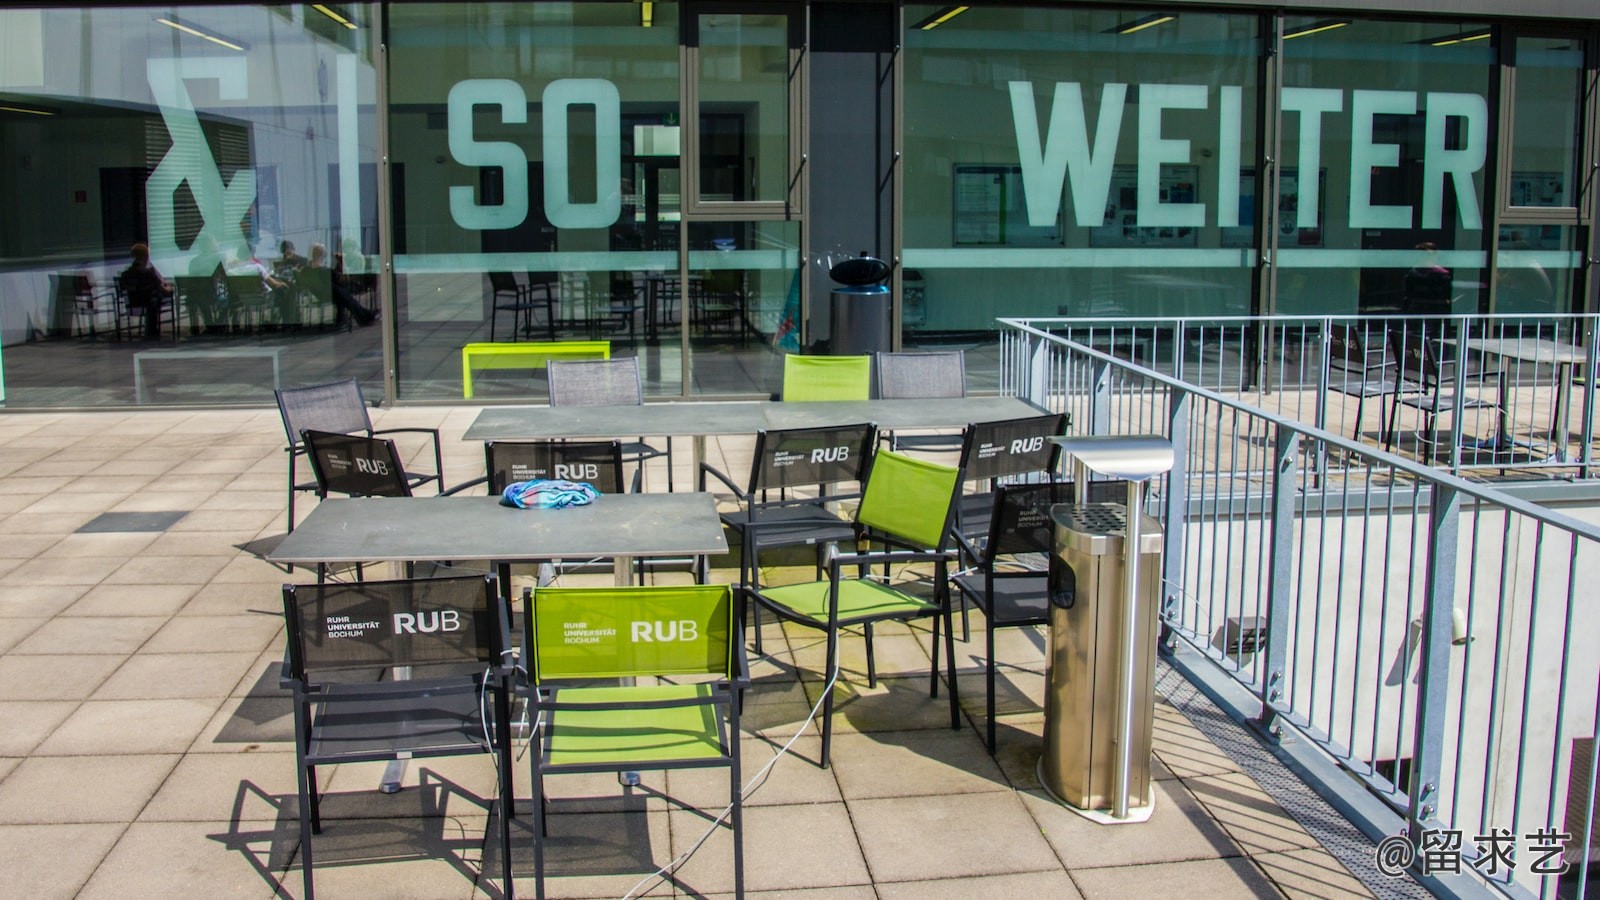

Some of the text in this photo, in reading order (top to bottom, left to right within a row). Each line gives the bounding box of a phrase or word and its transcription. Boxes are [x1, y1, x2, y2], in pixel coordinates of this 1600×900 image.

[448, 78, 621, 230] SO
[1008, 80, 1489, 231] WEITER
[1009, 436, 1044, 455] RUB
[810, 446, 849, 464] RUB
[355, 457, 389, 476] RUB
[554, 463, 599, 480] RUB
[326, 616, 350, 624] RUHR
[327, 621, 380, 631] UNIVERSITÄT
[393, 610, 460, 635] RUB
[328, 630, 363, 638] BOCHUM
[563, 628, 617, 637] UNIVERSITÄT
[631, 620, 698, 643] RUB
